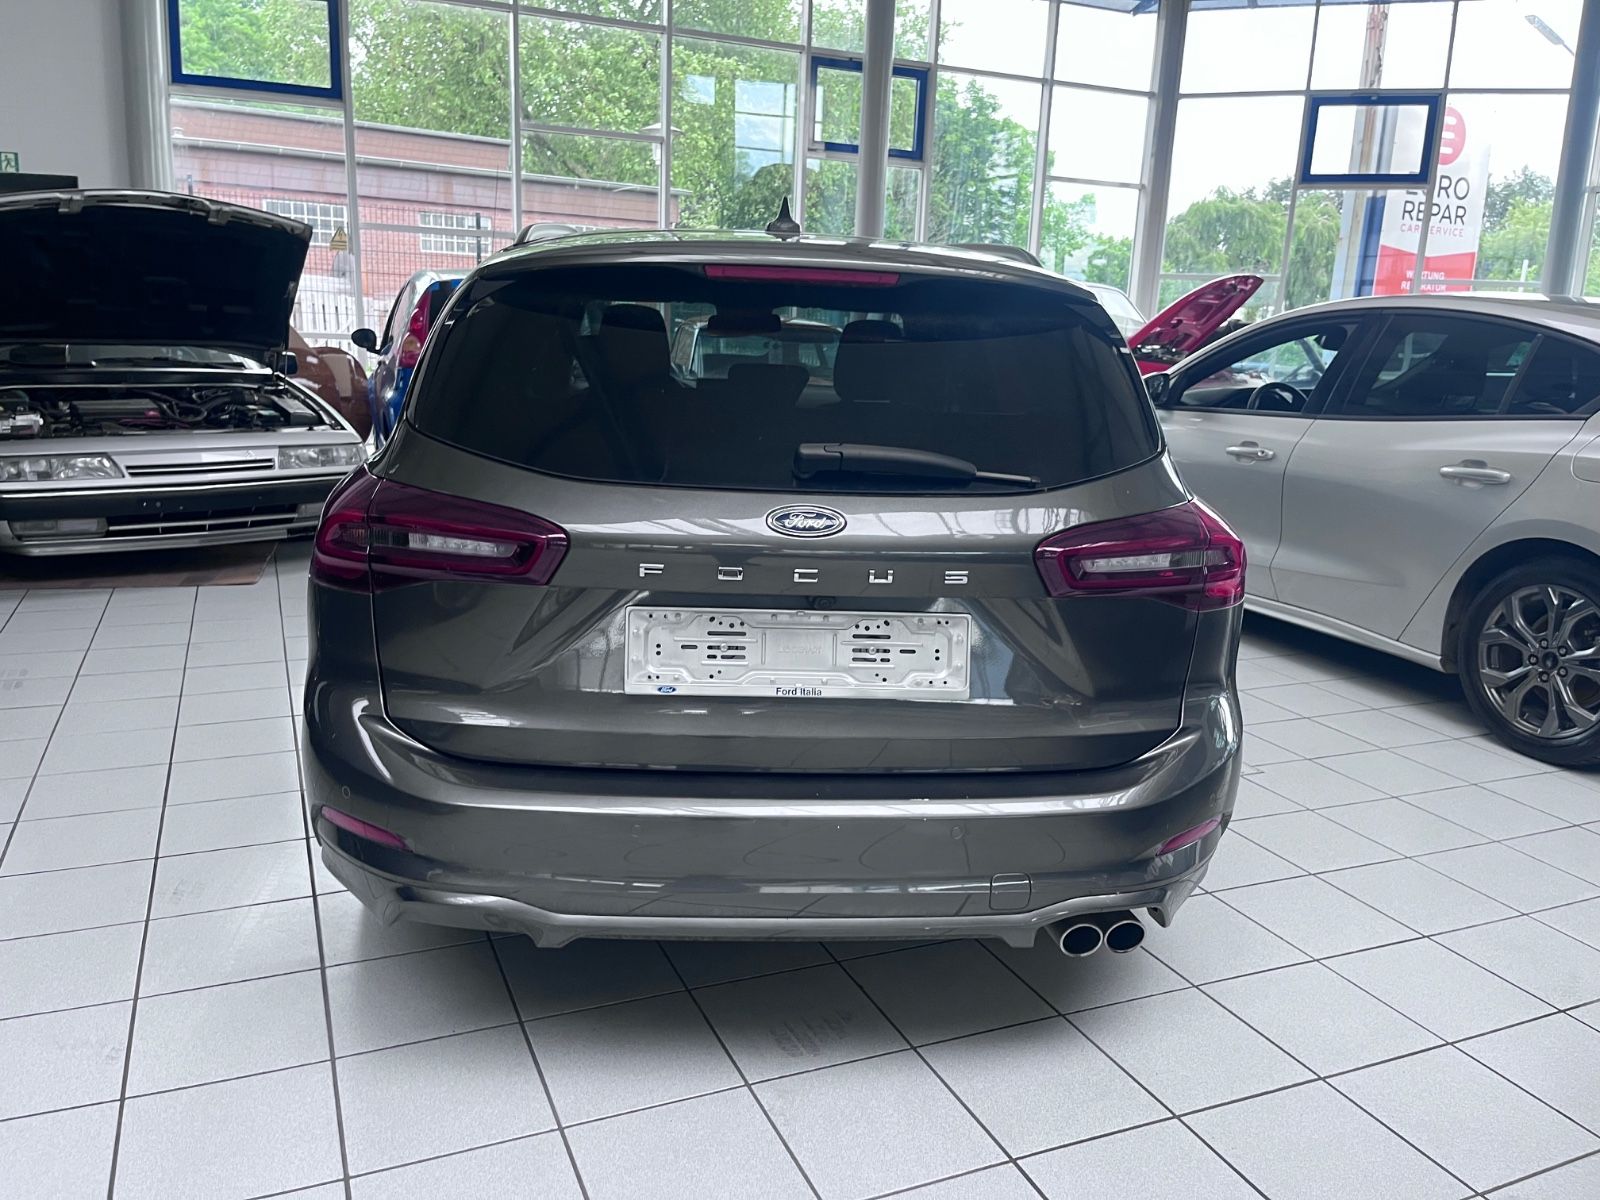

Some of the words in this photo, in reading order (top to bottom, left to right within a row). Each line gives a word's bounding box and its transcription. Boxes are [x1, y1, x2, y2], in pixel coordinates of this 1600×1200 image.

[1406, 172, 1470, 200] RO
[1400, 223, 1420, 233] CAR
[1422, 225, 1464, 238] ERVICE
[639, 563, 969, 585] FOCUS
[776, 687, 798, 696] Ford
[800, 687, 822, 697] Italia
